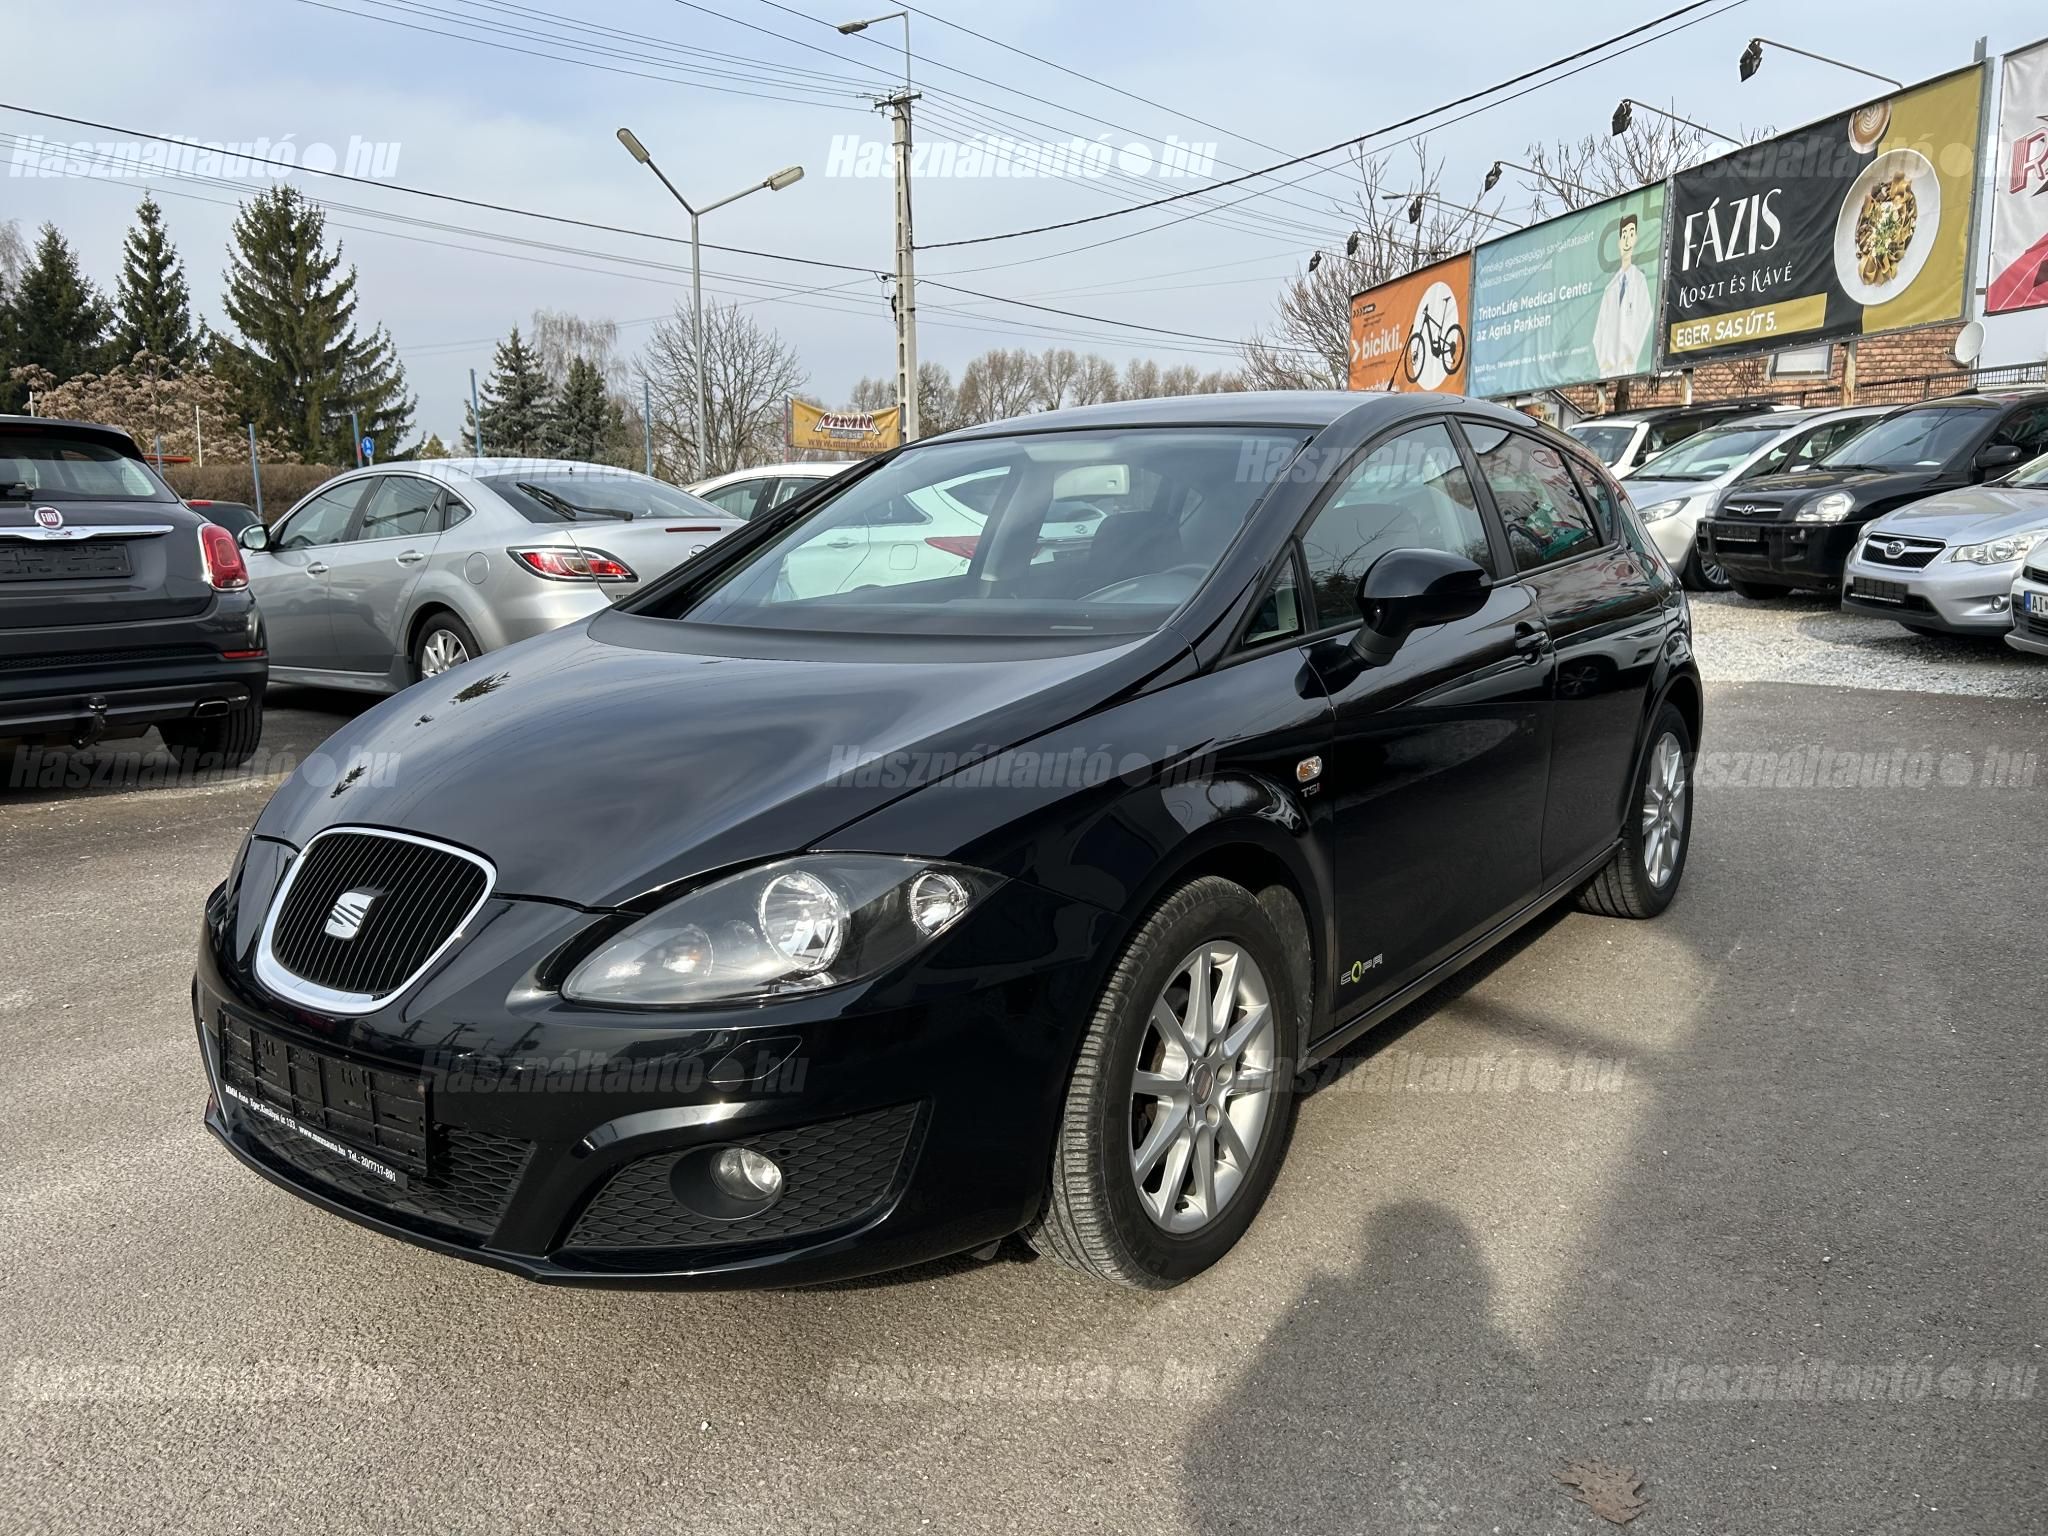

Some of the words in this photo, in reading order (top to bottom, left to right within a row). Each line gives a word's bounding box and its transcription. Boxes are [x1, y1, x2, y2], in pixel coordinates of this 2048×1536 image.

[1682, 188, 1782, 271] FÁZIS
[1478, 300, 1519, 321] TritonLife
[1521, 288, 1557, 310] Medical
[1559, 282, 1592, 300] Center
[1679, 281, 1725, 308] KOSZT
[1730, 274, 1746, 294] ÉS
[1751, 261, 1793, 293] KÁVÉ
[1476, 329, 1486, 342] az
[1488, 322, 1511, 340] Agria
[1514, 314, 1551, 334] Parkban
[1676, 323, 1712, 347] EGER,
[1715, 317, 1743, 341] SAS
[1745, 310, 1765, 334] ÚT
[1766, 311, 1777, 331] 5.
[40, 511, 59, 523] FIAT
[1301, 782, 1321, 798] TSI
